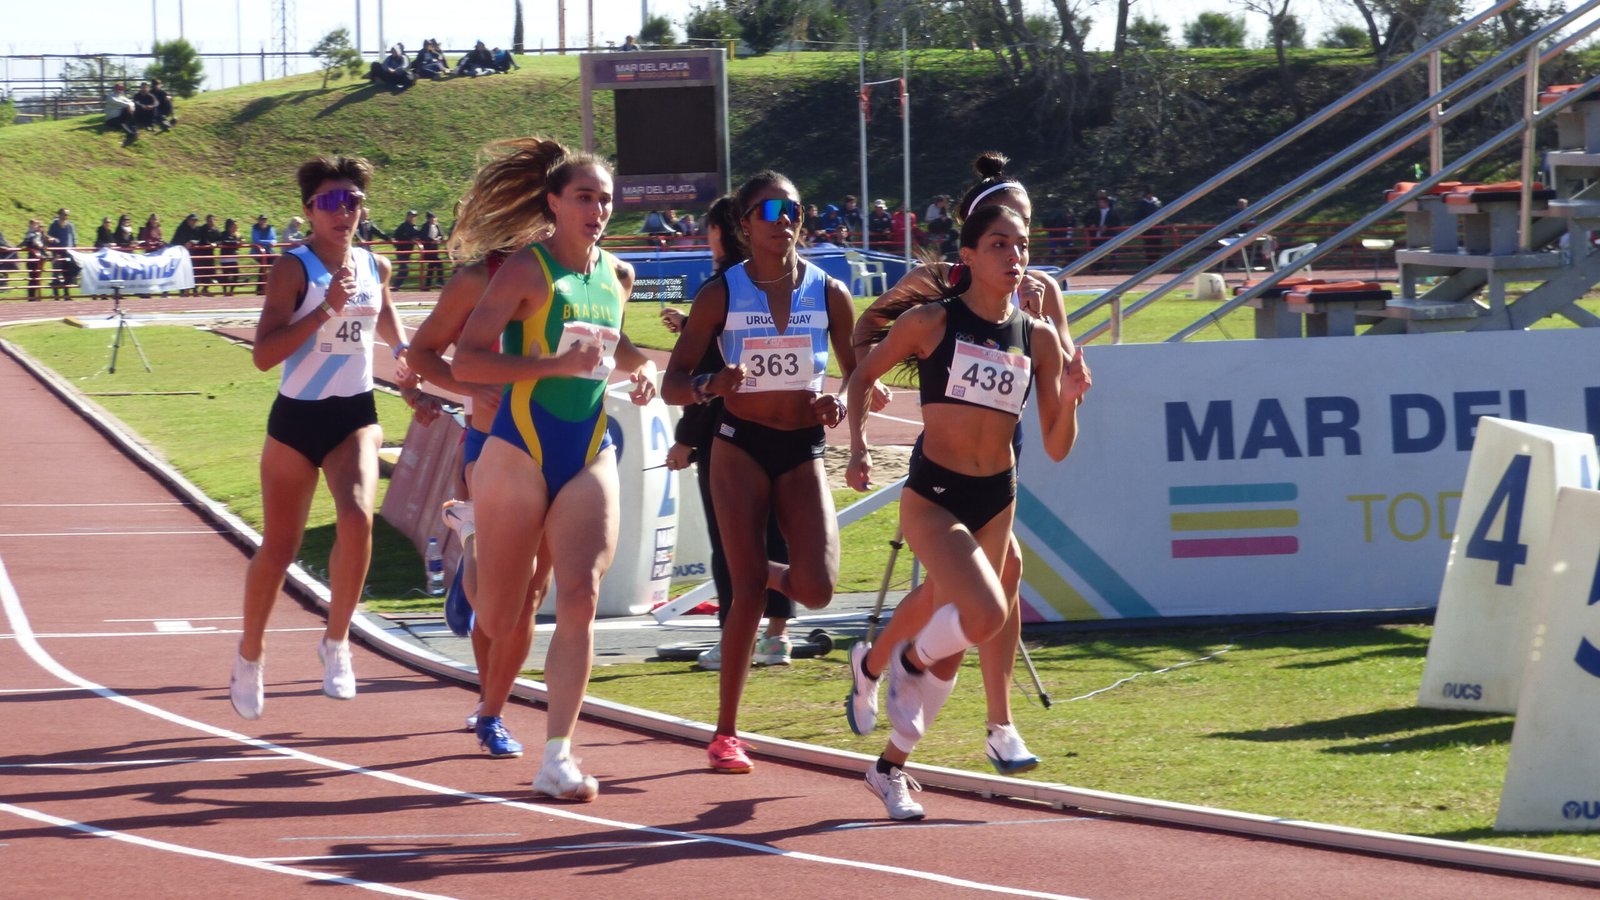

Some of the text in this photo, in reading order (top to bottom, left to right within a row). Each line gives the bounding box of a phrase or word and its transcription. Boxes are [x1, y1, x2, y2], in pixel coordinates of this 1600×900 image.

[615, 61, 690, 72] MAR DEL PLATA
[622, 184, 697, 195] MAR DEL PLATA
[563, 303, 613, 321] BRASIL
[336, 321, 362, 342] 48
[750, 353, 799, 377] 363
[961, 363, 1015, 395] 438
[1165, 396, 1361, 462] MAR
[1465, 454, 1532, 586] 4
